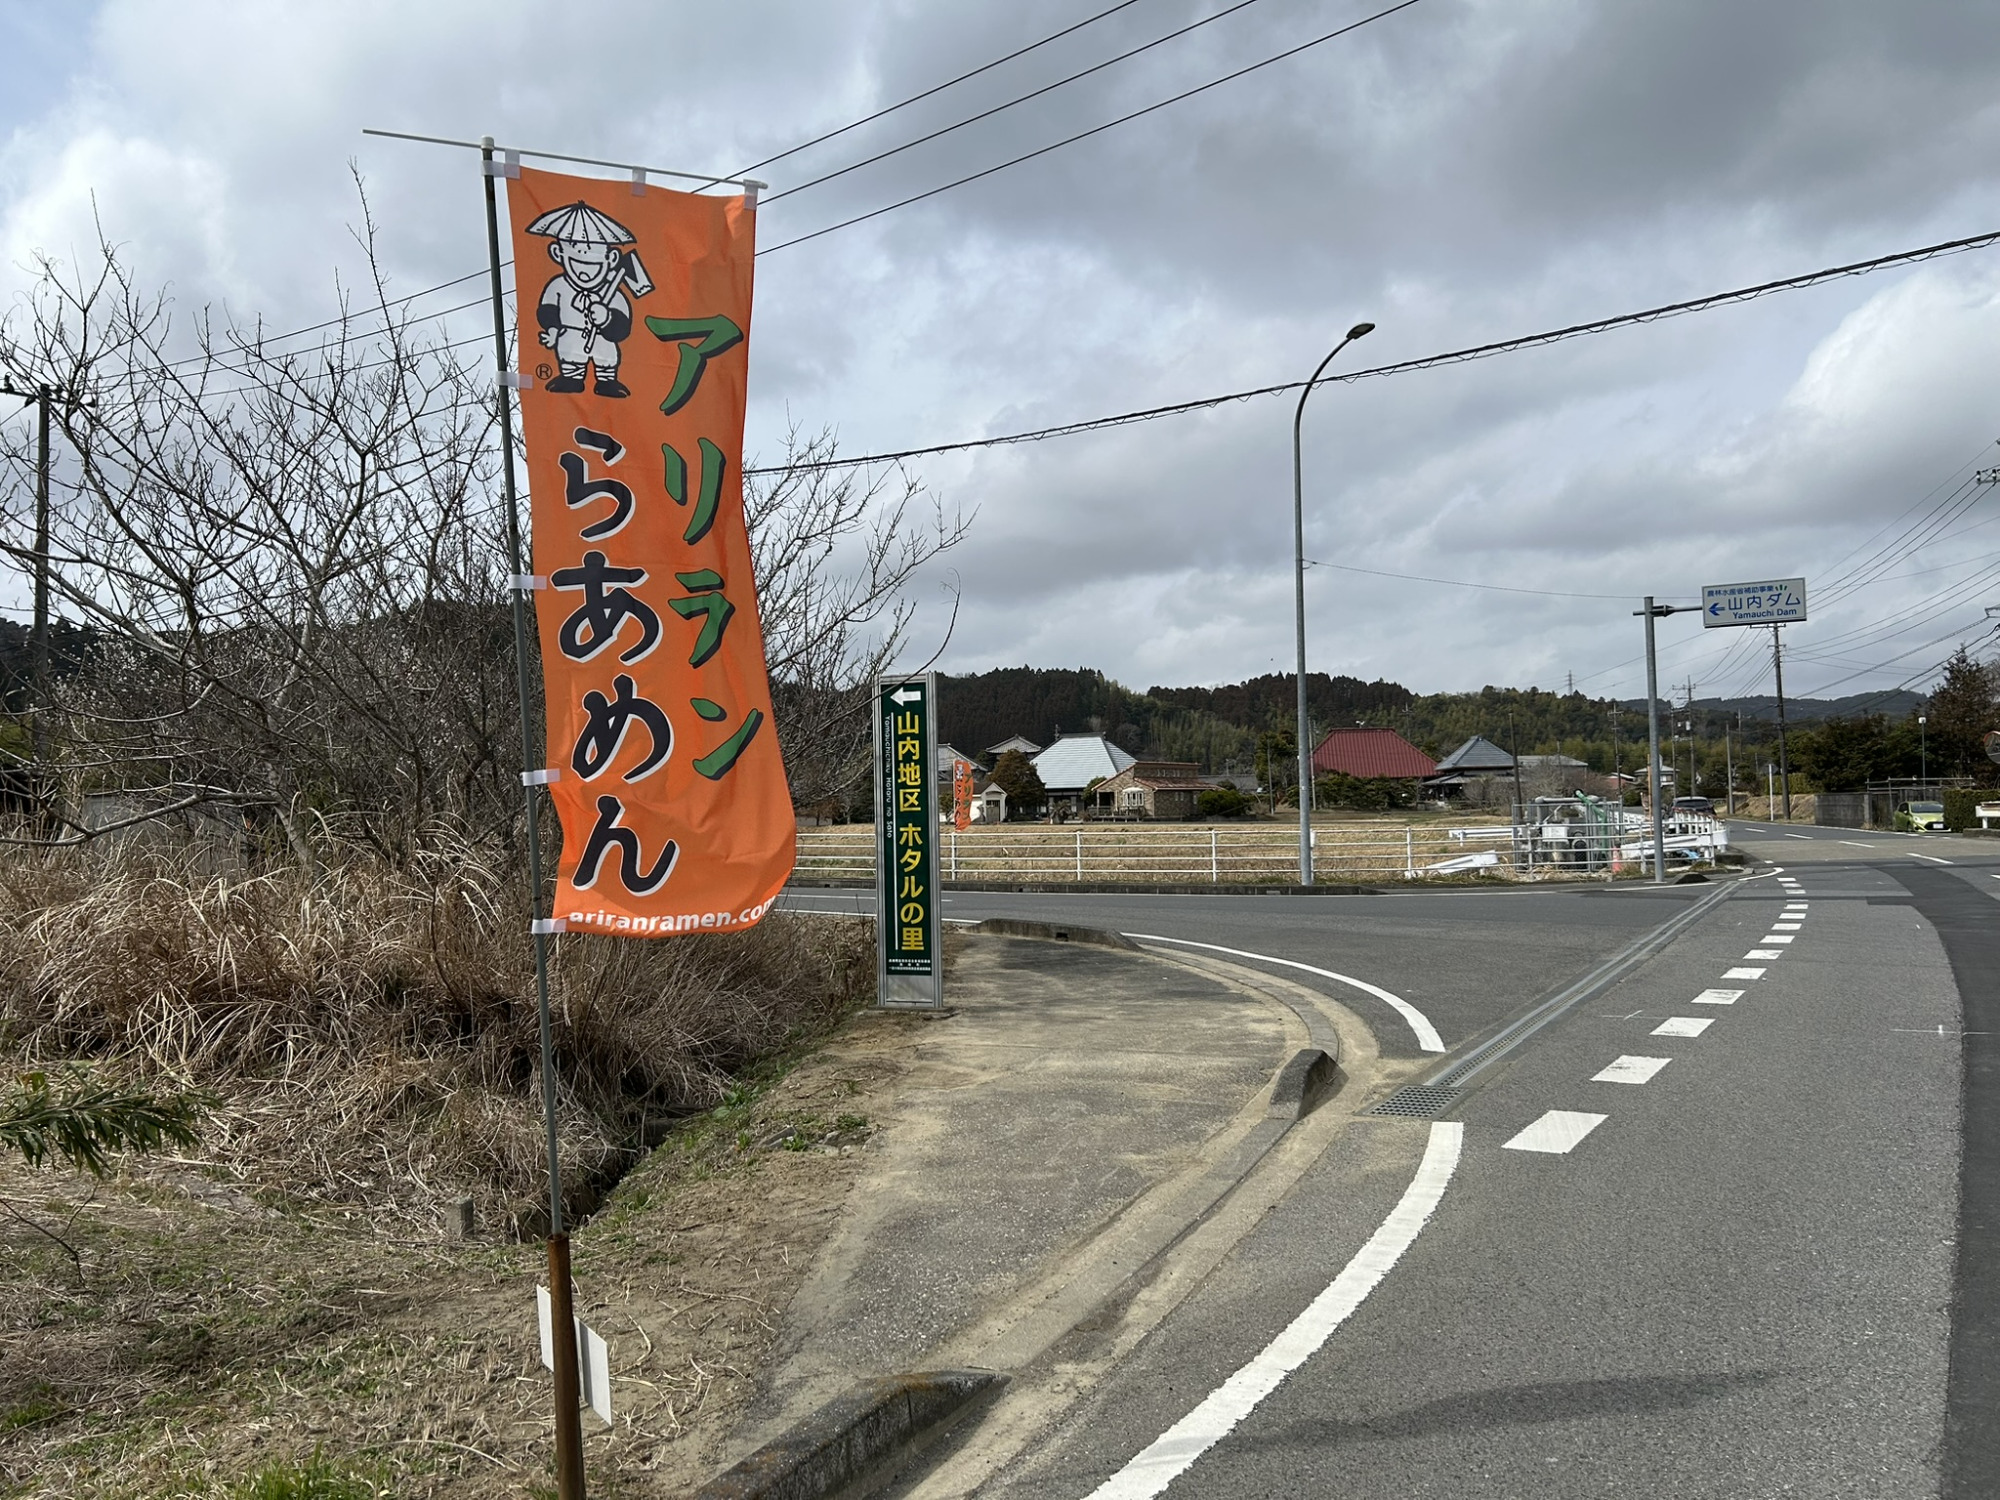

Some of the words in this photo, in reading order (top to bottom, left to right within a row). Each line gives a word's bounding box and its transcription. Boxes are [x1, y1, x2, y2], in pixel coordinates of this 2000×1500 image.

[645, 314, 764, 780] アリラン
[1707, 585, 1774, 597] 農林水産省補助事業
[1728, 592, 1801, 611] 山内ダム
[1732, 609, 1775, 619] Yamauchi
[1777, 608, 1797, 616] Dam
[550, 425, 679, 895] らあめん
[897, 711, 922, 812] 山内地区
[898, 822, 925, 951] ホタルの里
